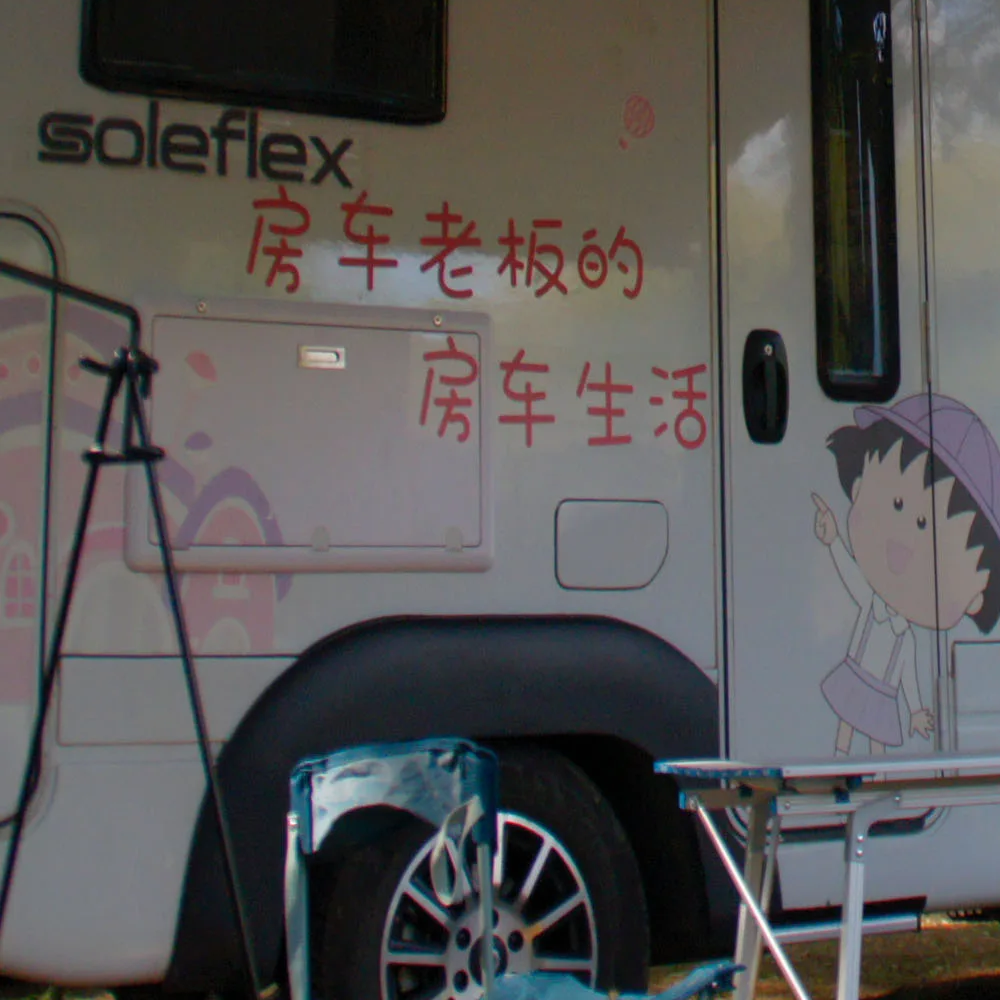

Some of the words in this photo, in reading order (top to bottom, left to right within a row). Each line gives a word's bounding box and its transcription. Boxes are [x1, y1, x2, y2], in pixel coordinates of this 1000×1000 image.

[37, 100, 354, 189] soleflex
[246, 185, 643, 299] 房车老板的
[420, 336, 707, 449] 房车生活
